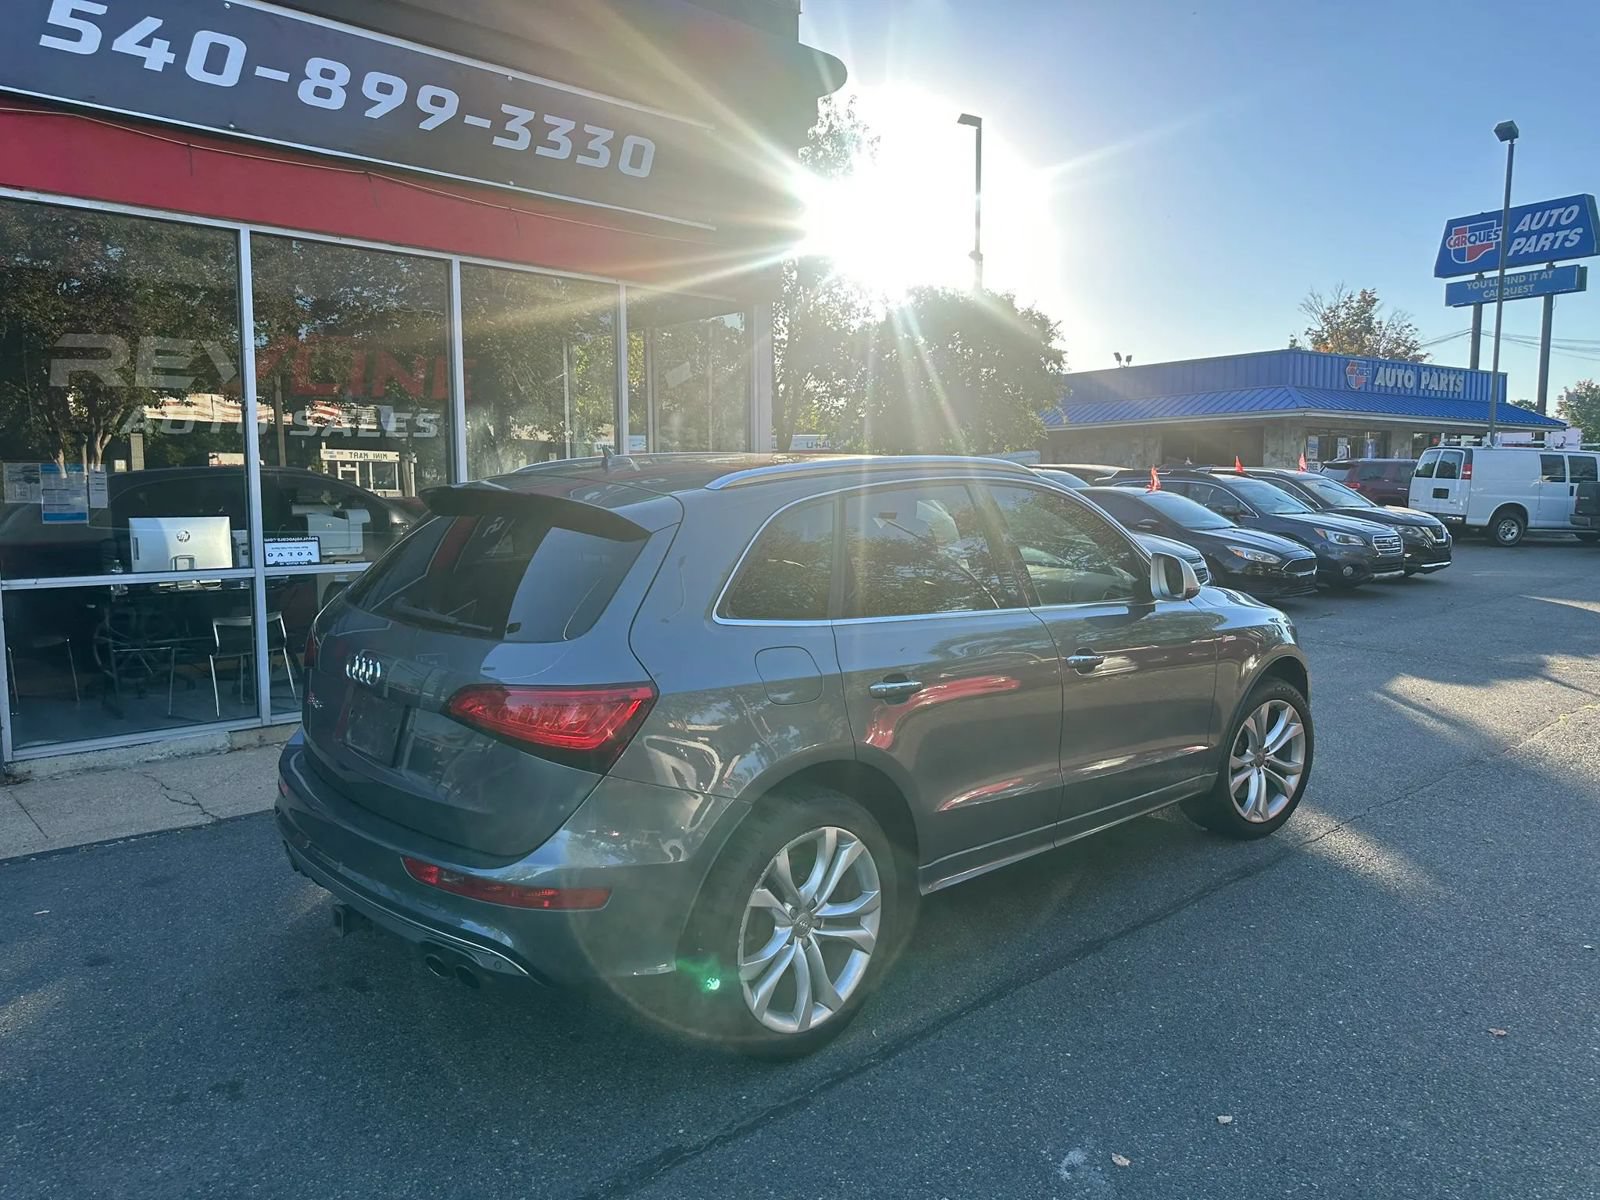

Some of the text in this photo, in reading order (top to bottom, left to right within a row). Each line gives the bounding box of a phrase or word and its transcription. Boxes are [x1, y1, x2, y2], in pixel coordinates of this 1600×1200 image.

[38, 0, 657, 179] 540-899-3330
[1513, 204, 1580, 234] AUTO
[1447, 228, 1503, 249] CARQUES
[1507, 227, 1584, 257] PARTS
[1529, 272, 1539, 282] IT
[1540, 270, 1554, 280] AT
[1483, 283, 1535, 298] CAQUEST
[1374, 366, 1465, 393] AUTO PARTS
[289, 408, 442, 439] SALES
[267, 551, 313, 559] VOLVO
